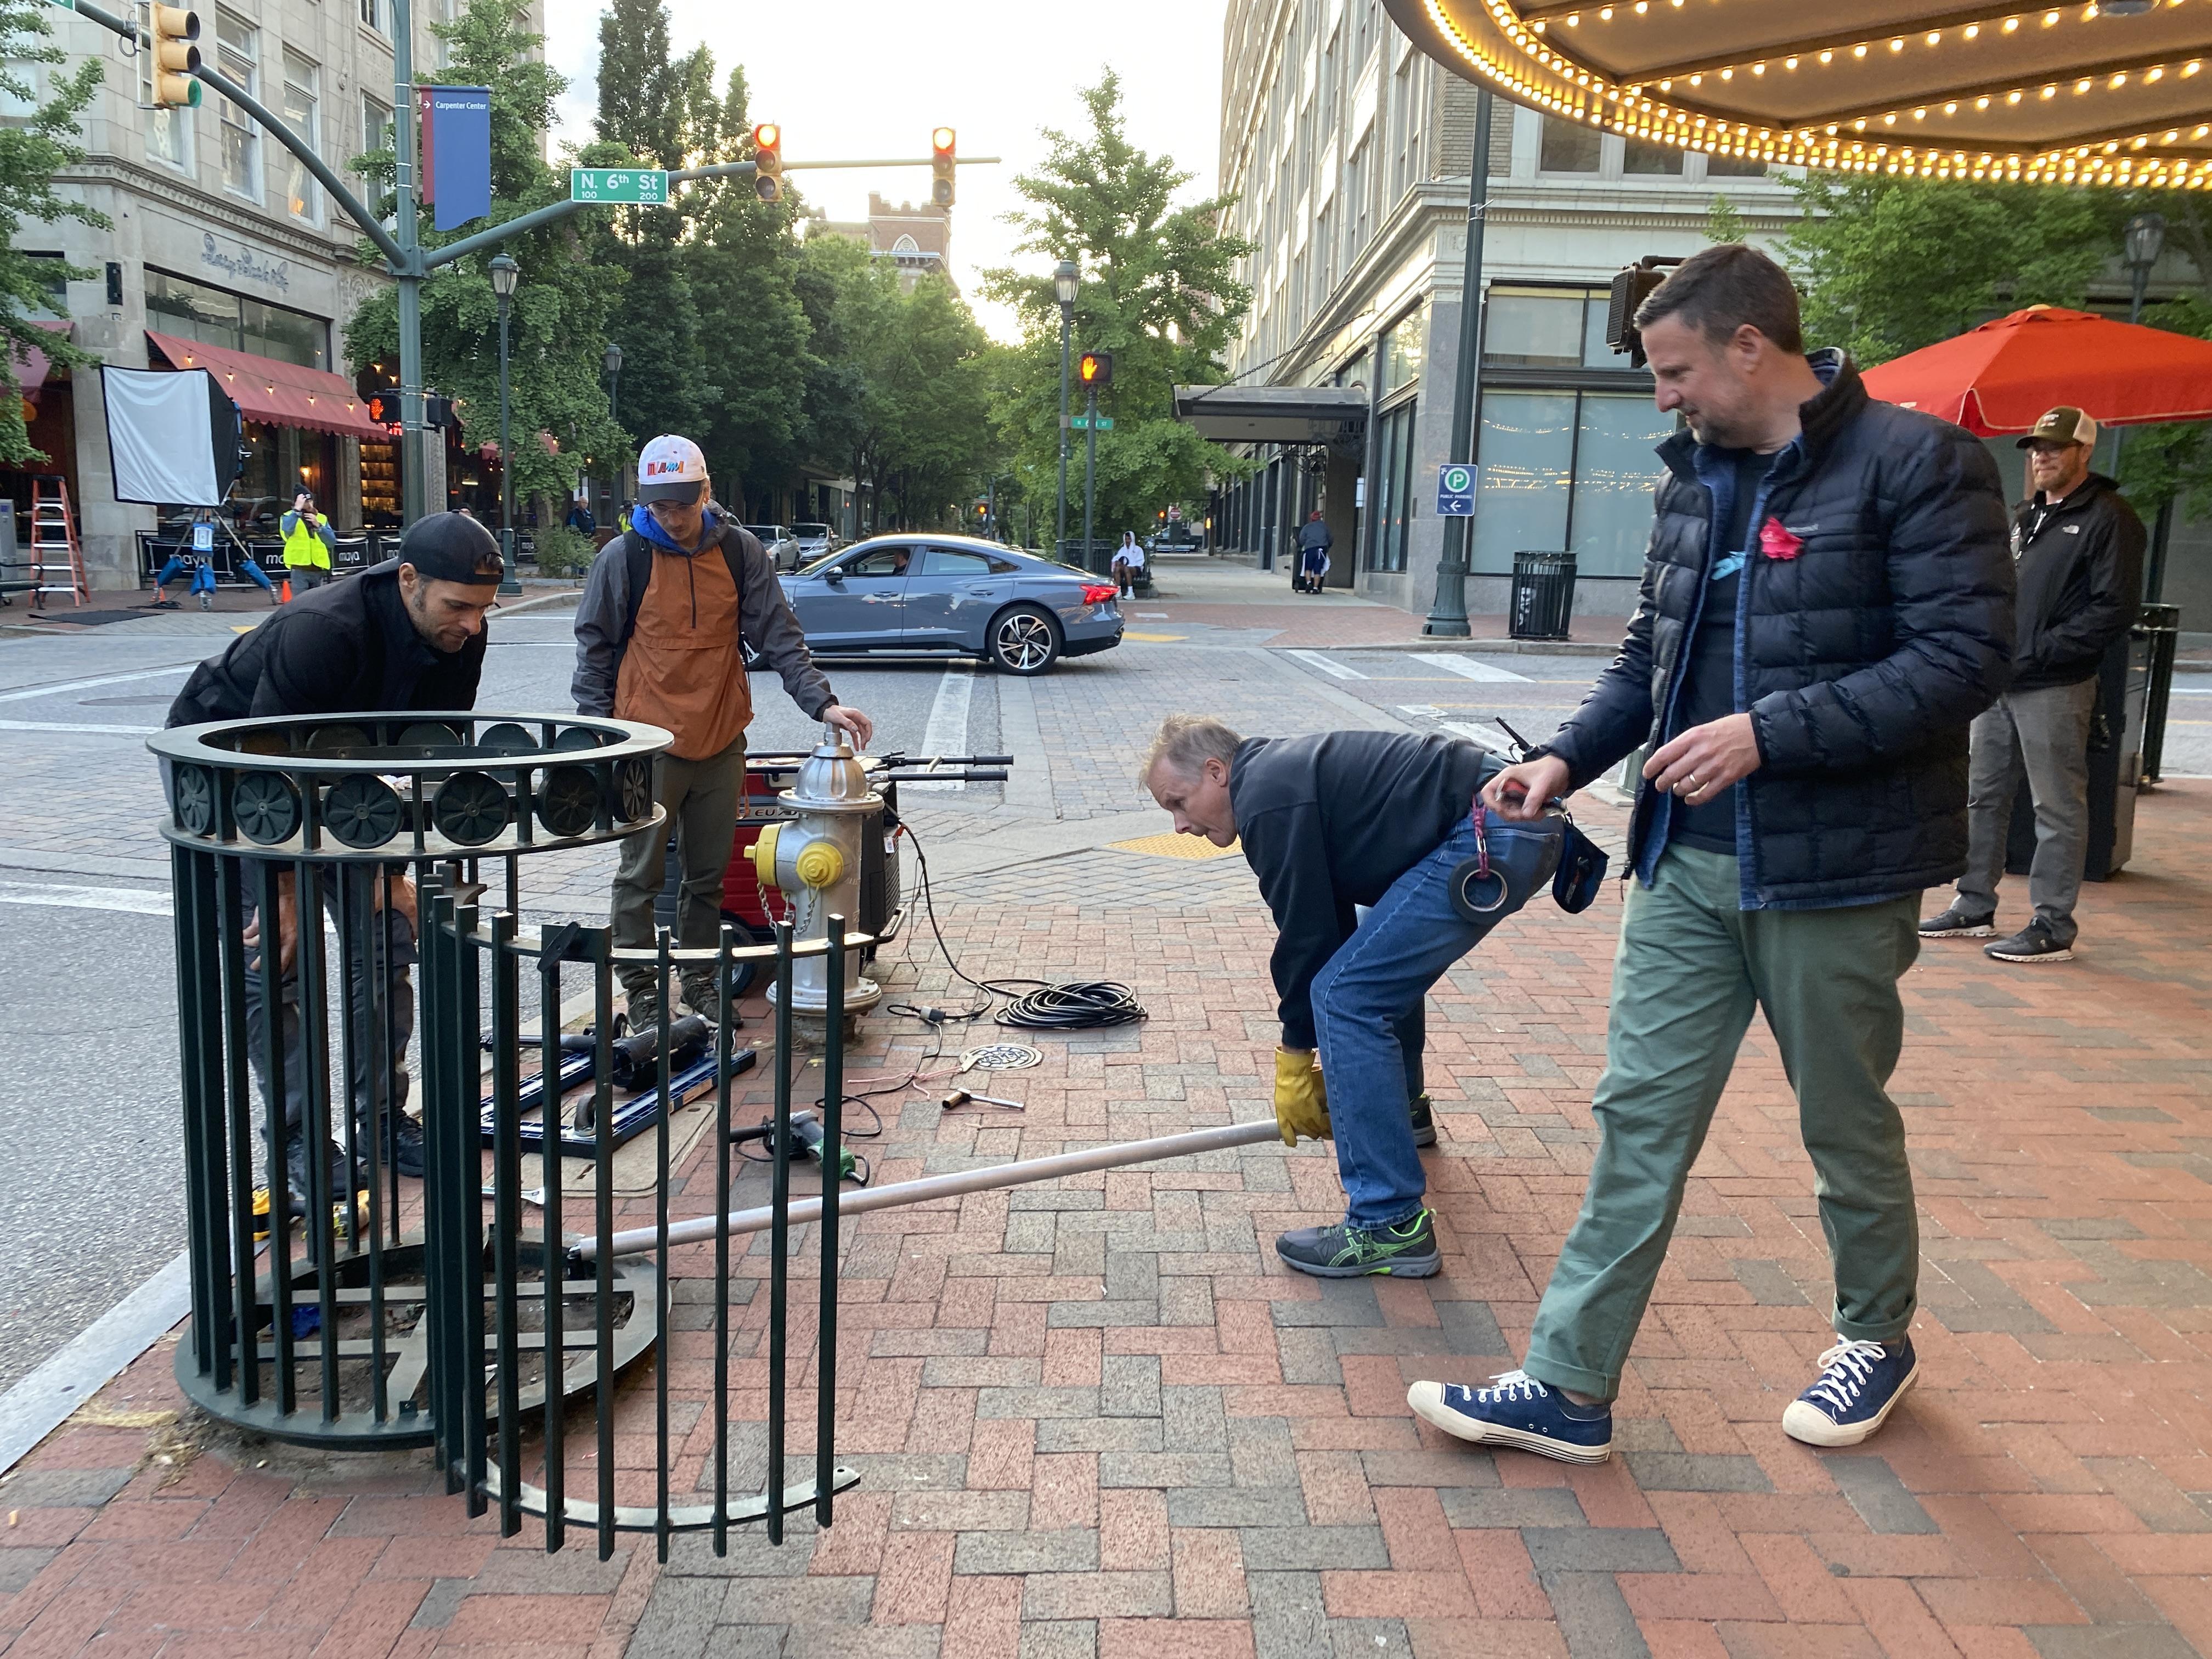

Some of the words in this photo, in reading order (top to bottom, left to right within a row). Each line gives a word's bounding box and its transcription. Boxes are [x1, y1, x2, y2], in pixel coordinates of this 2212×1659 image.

[436, 101, 465, 110] Carpenter
[581, 173, 598, 189] N.
[607, 174, 630, 189] 6th
[638, 174, 658, 190] St
[1453, 473, 1464, 487] P
[338, 551, 360, 564] maya
